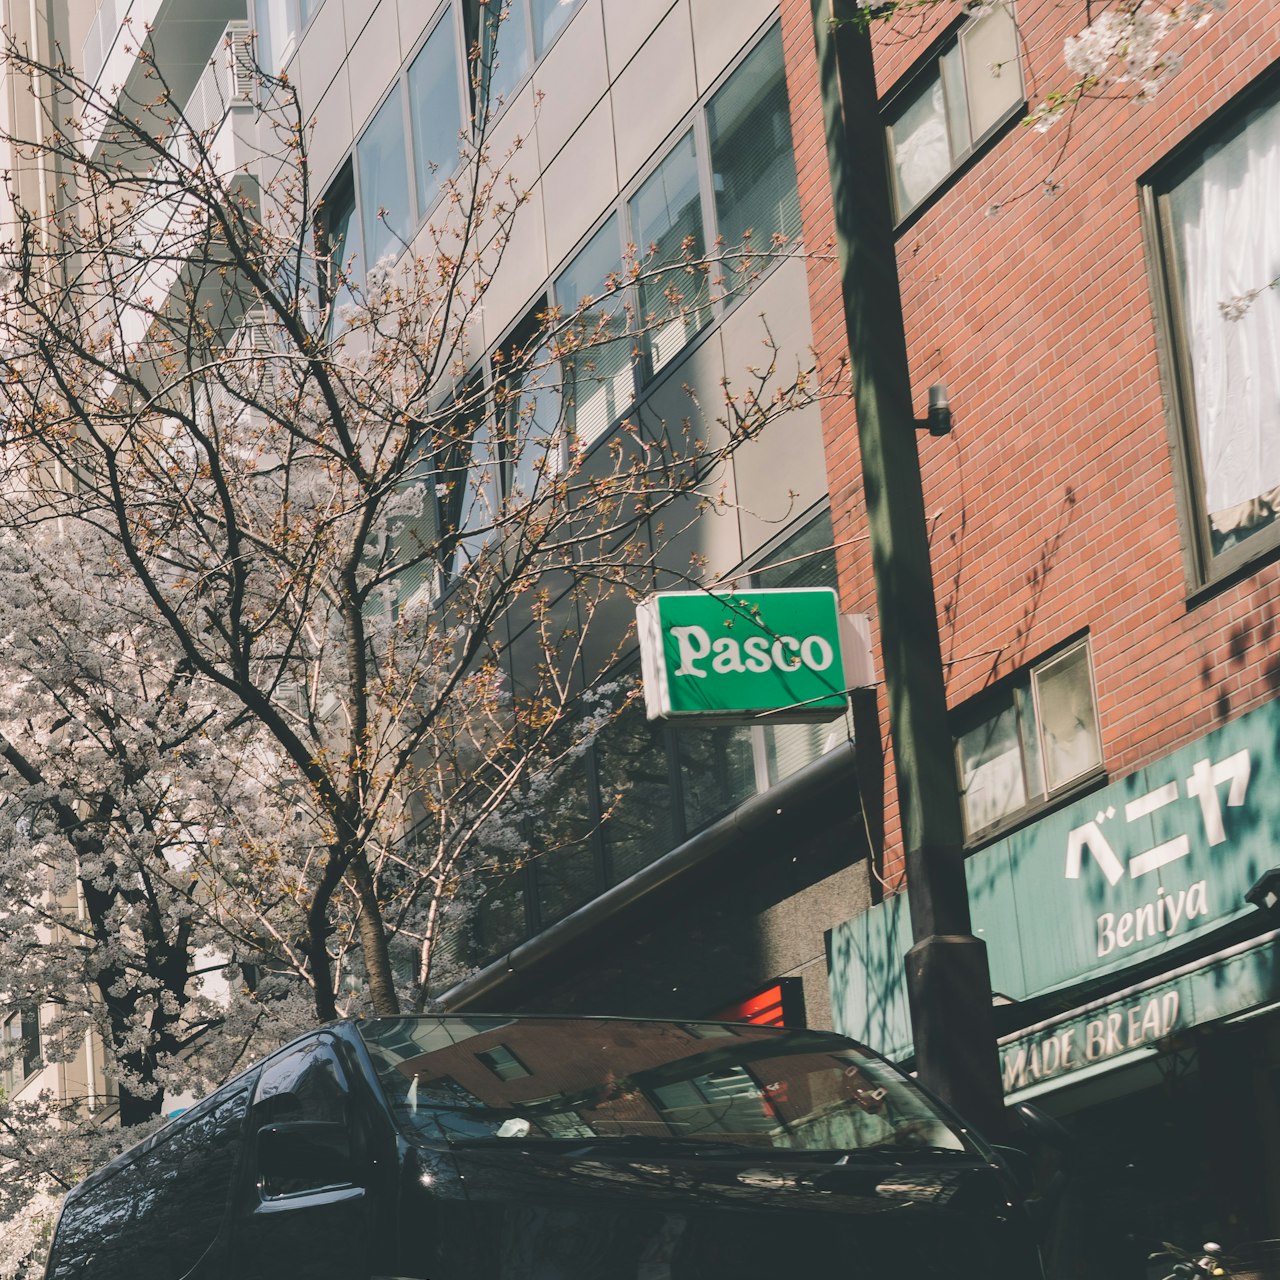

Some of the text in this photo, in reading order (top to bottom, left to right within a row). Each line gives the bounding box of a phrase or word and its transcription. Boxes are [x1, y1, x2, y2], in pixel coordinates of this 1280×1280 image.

[669, 626, 834, 678] Pasco
[1064, 747, 1252, 887] ベニヤ
[1095, 878, 1209, 959] Beniya
[1003, 990, 1180, 1091] MADE BREAD
